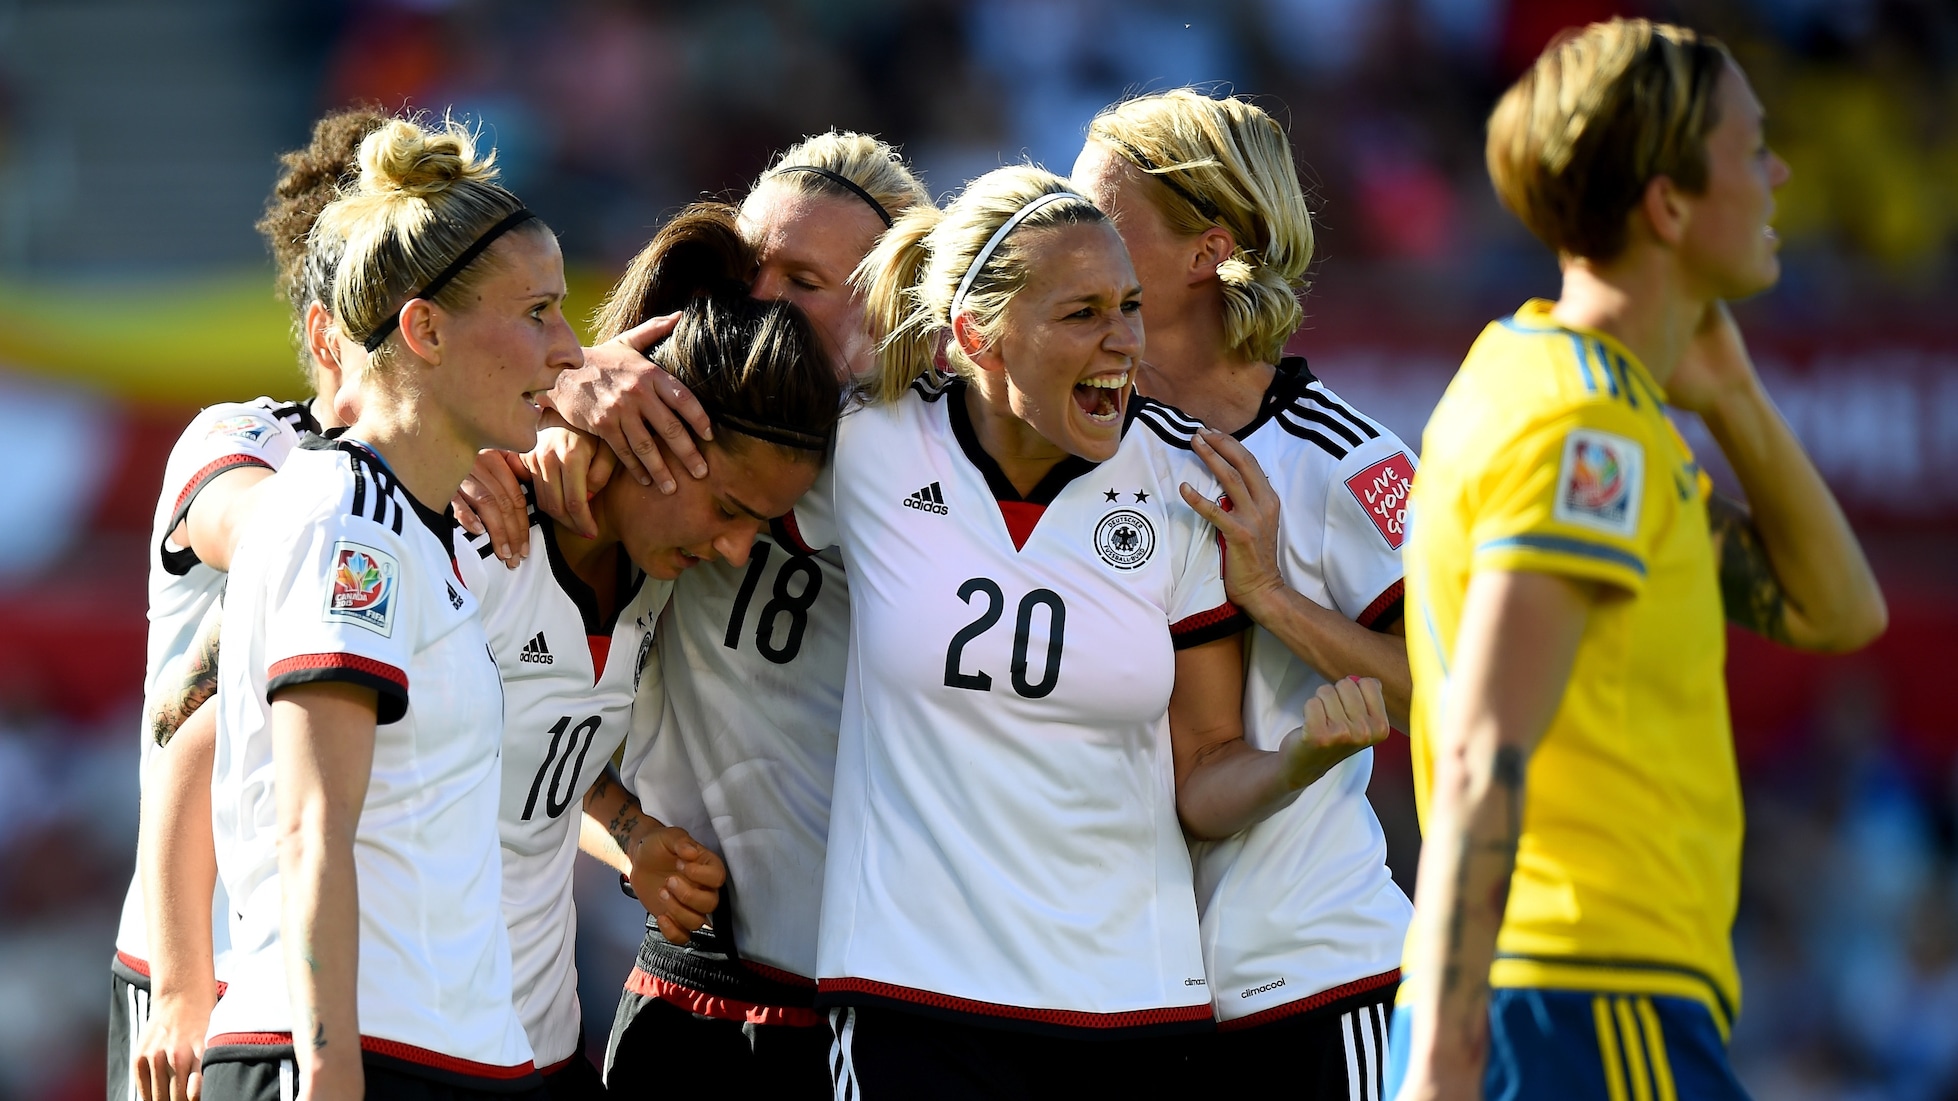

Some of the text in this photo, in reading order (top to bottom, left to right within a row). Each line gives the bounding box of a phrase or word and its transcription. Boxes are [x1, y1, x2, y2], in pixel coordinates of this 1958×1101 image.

[1364, 467, 1398, 504] LIVE
[903, 498, 949, 516] adidas
[1107, 516, 1143, 529] DEUTSCHER
[335, 593, 368, 602] CANADA
[724, 540, 822, 664] 18
[366, 610, 386, 622] FIFA
[944, 577, 1066, 699] 20
[519, 651, 554, 665] adidas
[520, 715, 603, 820] 10
[1241, 977, 1286, 999] climacool
